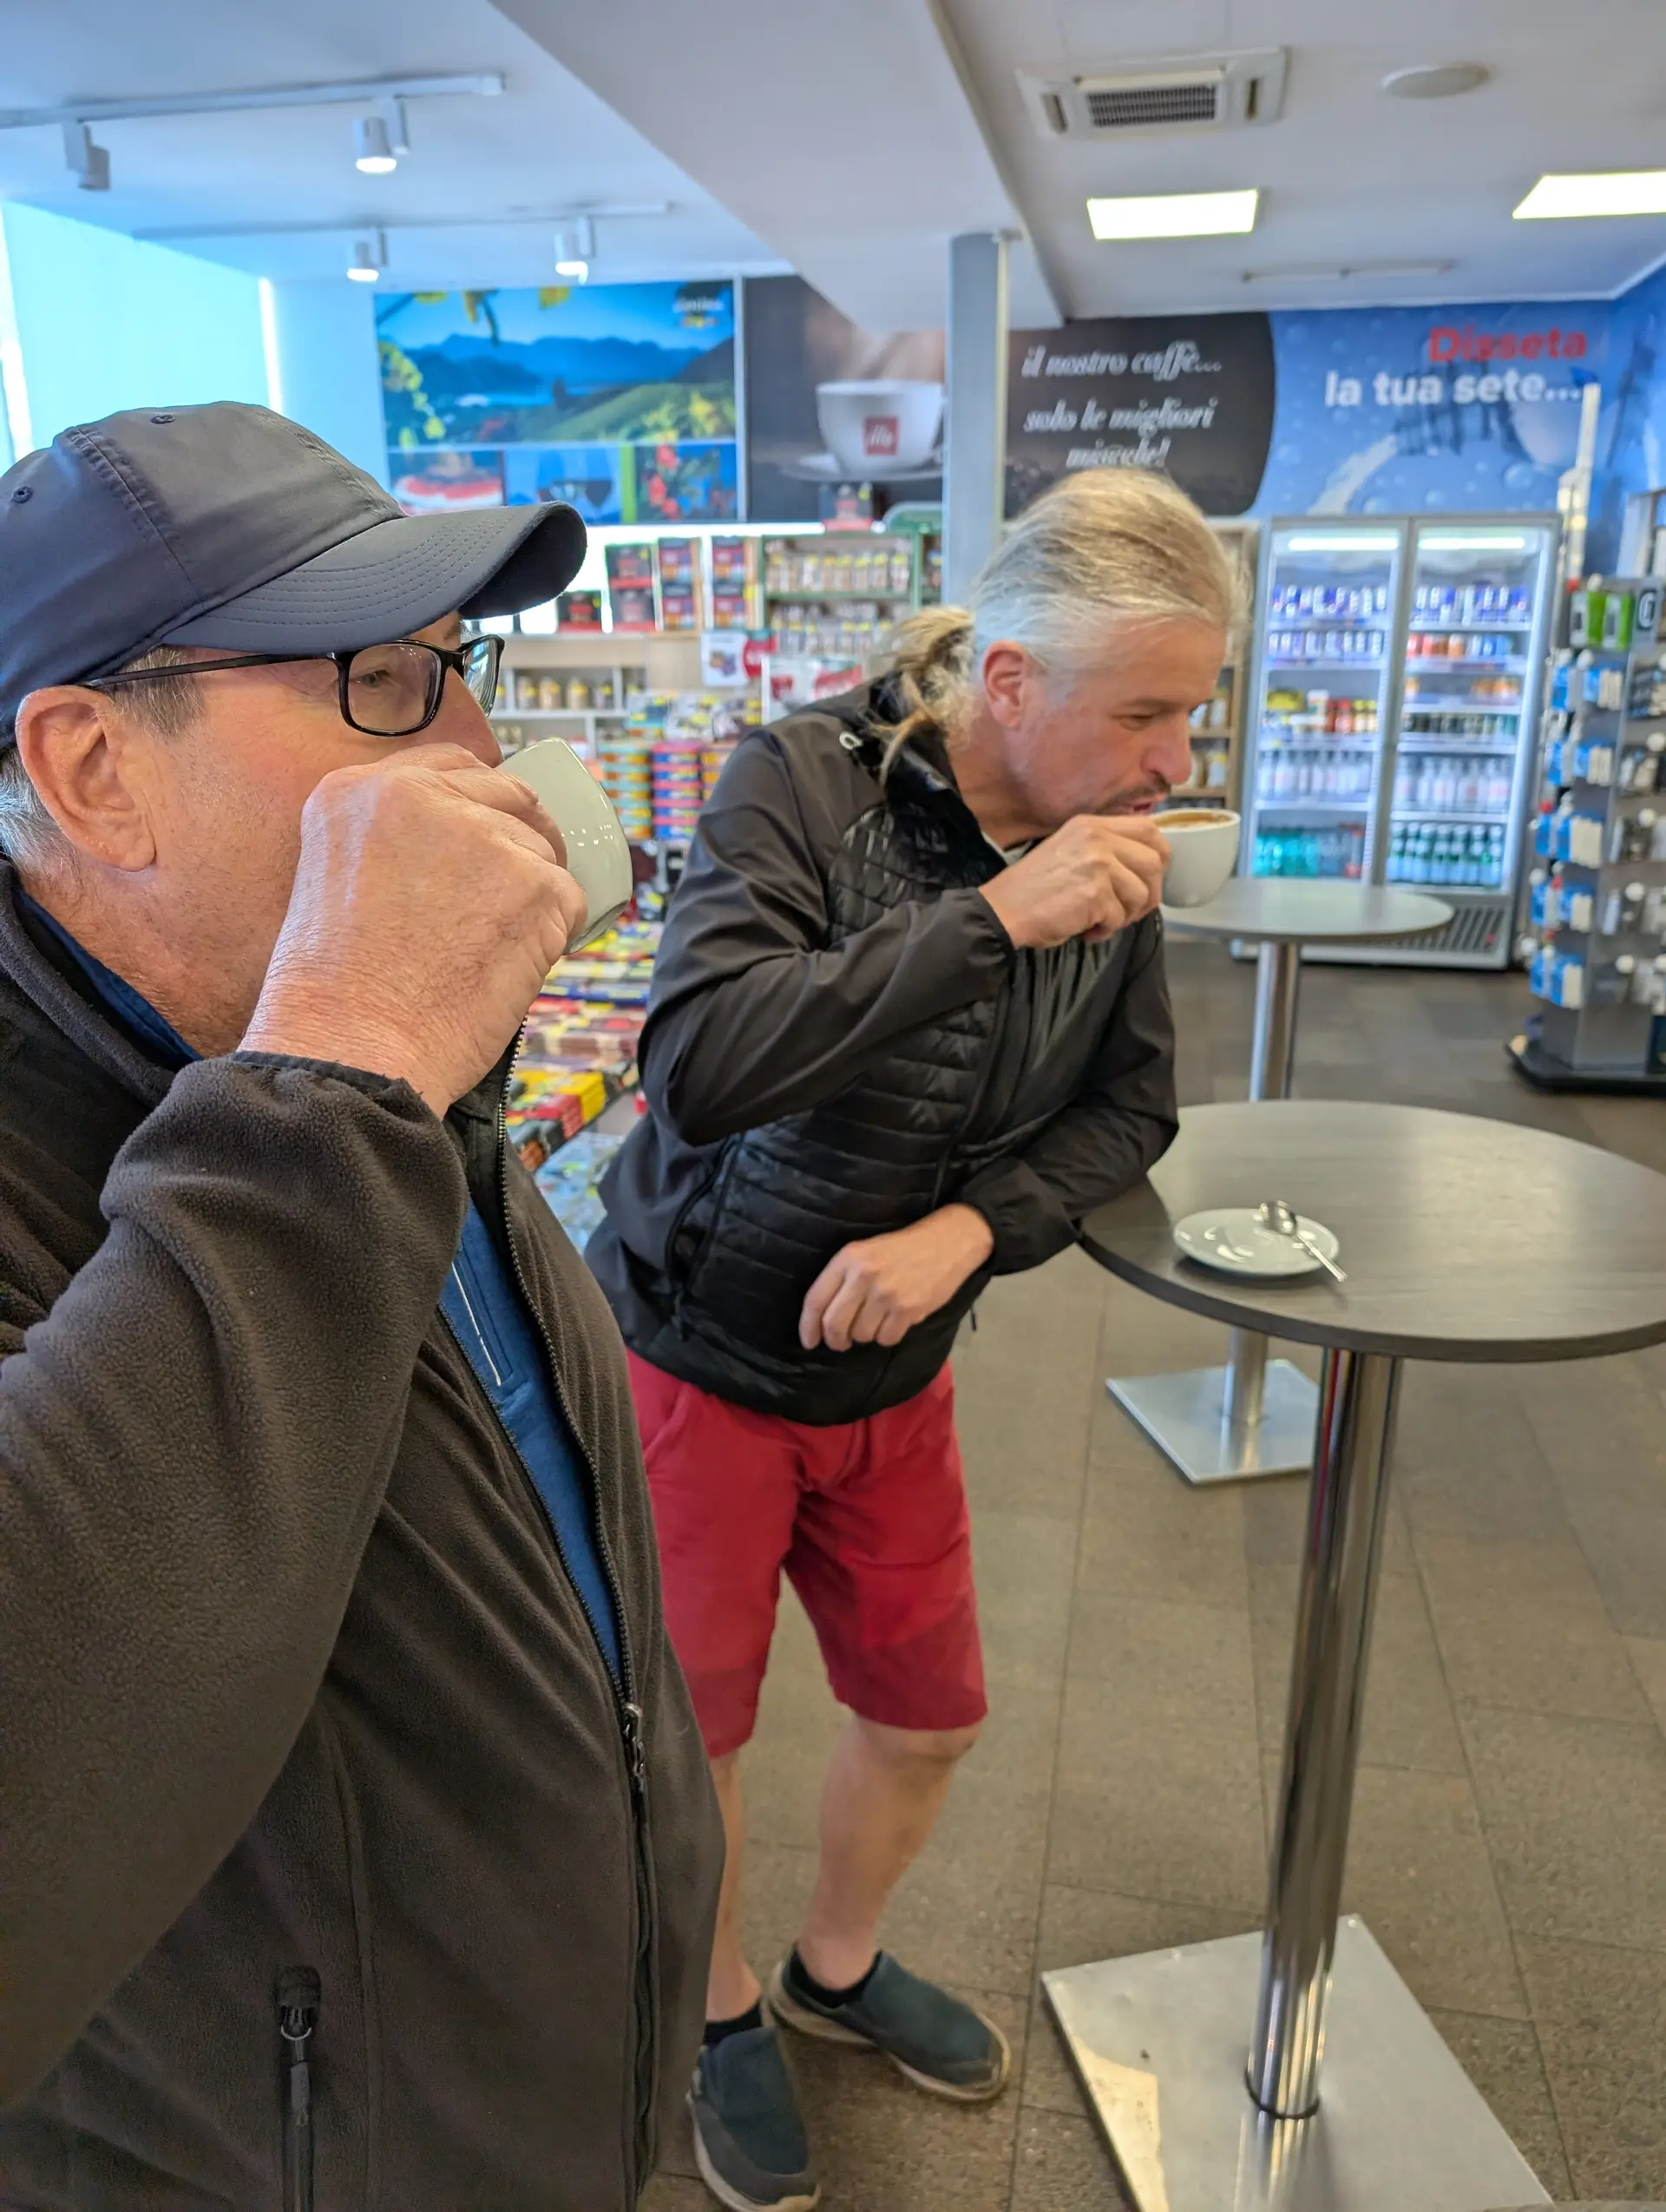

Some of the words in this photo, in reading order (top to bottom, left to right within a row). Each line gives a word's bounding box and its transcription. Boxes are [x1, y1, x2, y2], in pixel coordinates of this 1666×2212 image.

[1021, 345, 1046, 377] il
[1046, 350, 1128, 377] nostro
[1428, 324, 1587, 362] Disseta
[1325, 370, 1362, 406] la
[1373, 371, 1443, 405] tua
[1023, 398, 1078, 432] solo
[1079, 397, 1107, 430] le
[1108, 396, 1218, 439] migliori
